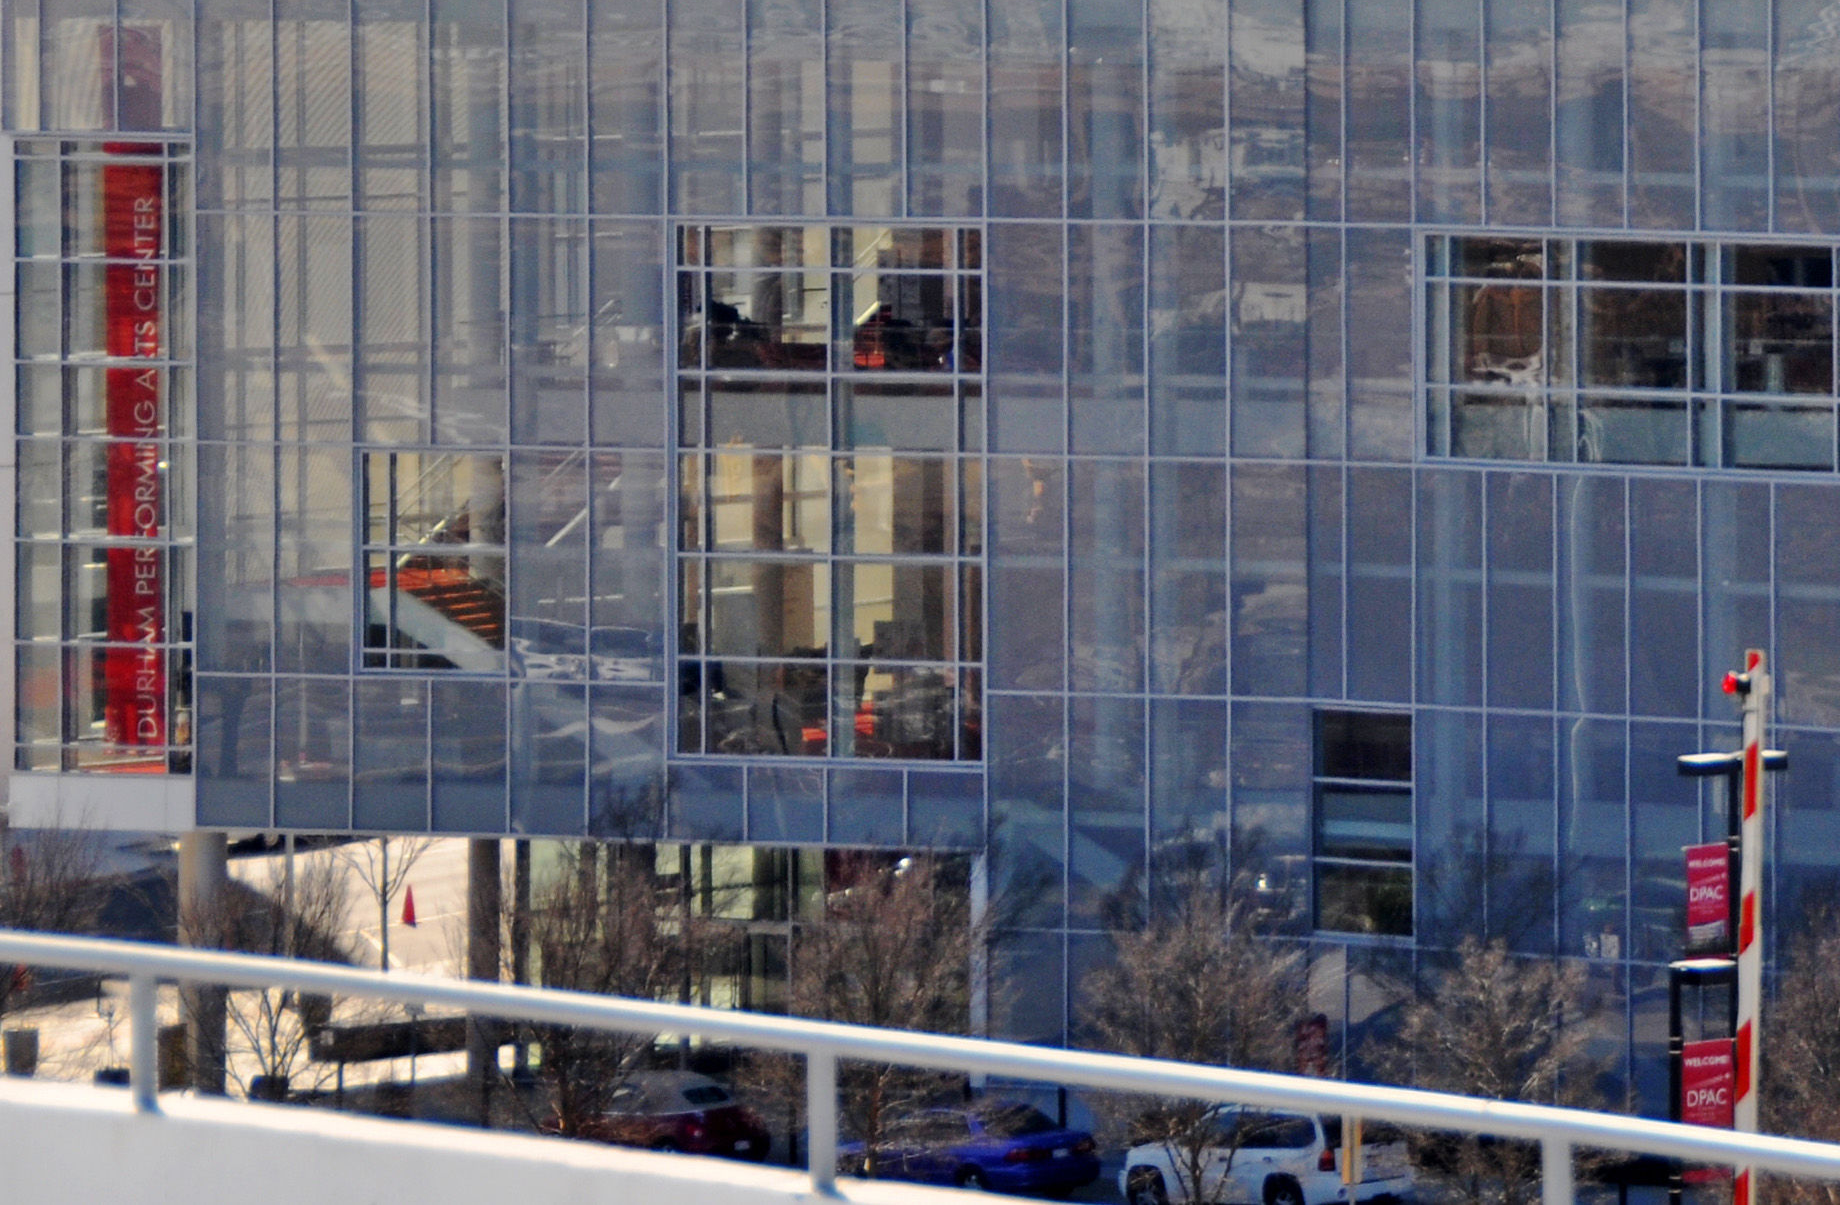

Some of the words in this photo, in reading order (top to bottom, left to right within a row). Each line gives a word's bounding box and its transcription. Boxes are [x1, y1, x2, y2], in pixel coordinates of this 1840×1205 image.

[134, 197, 155, 311] CENTER
[135, 320, 156, 391] ATS
[136, 606, 157, 738] DURHAM
[1690, 884, 1724, 903] DPAC
[1687, 1087, 1727, 1108] DPAC
